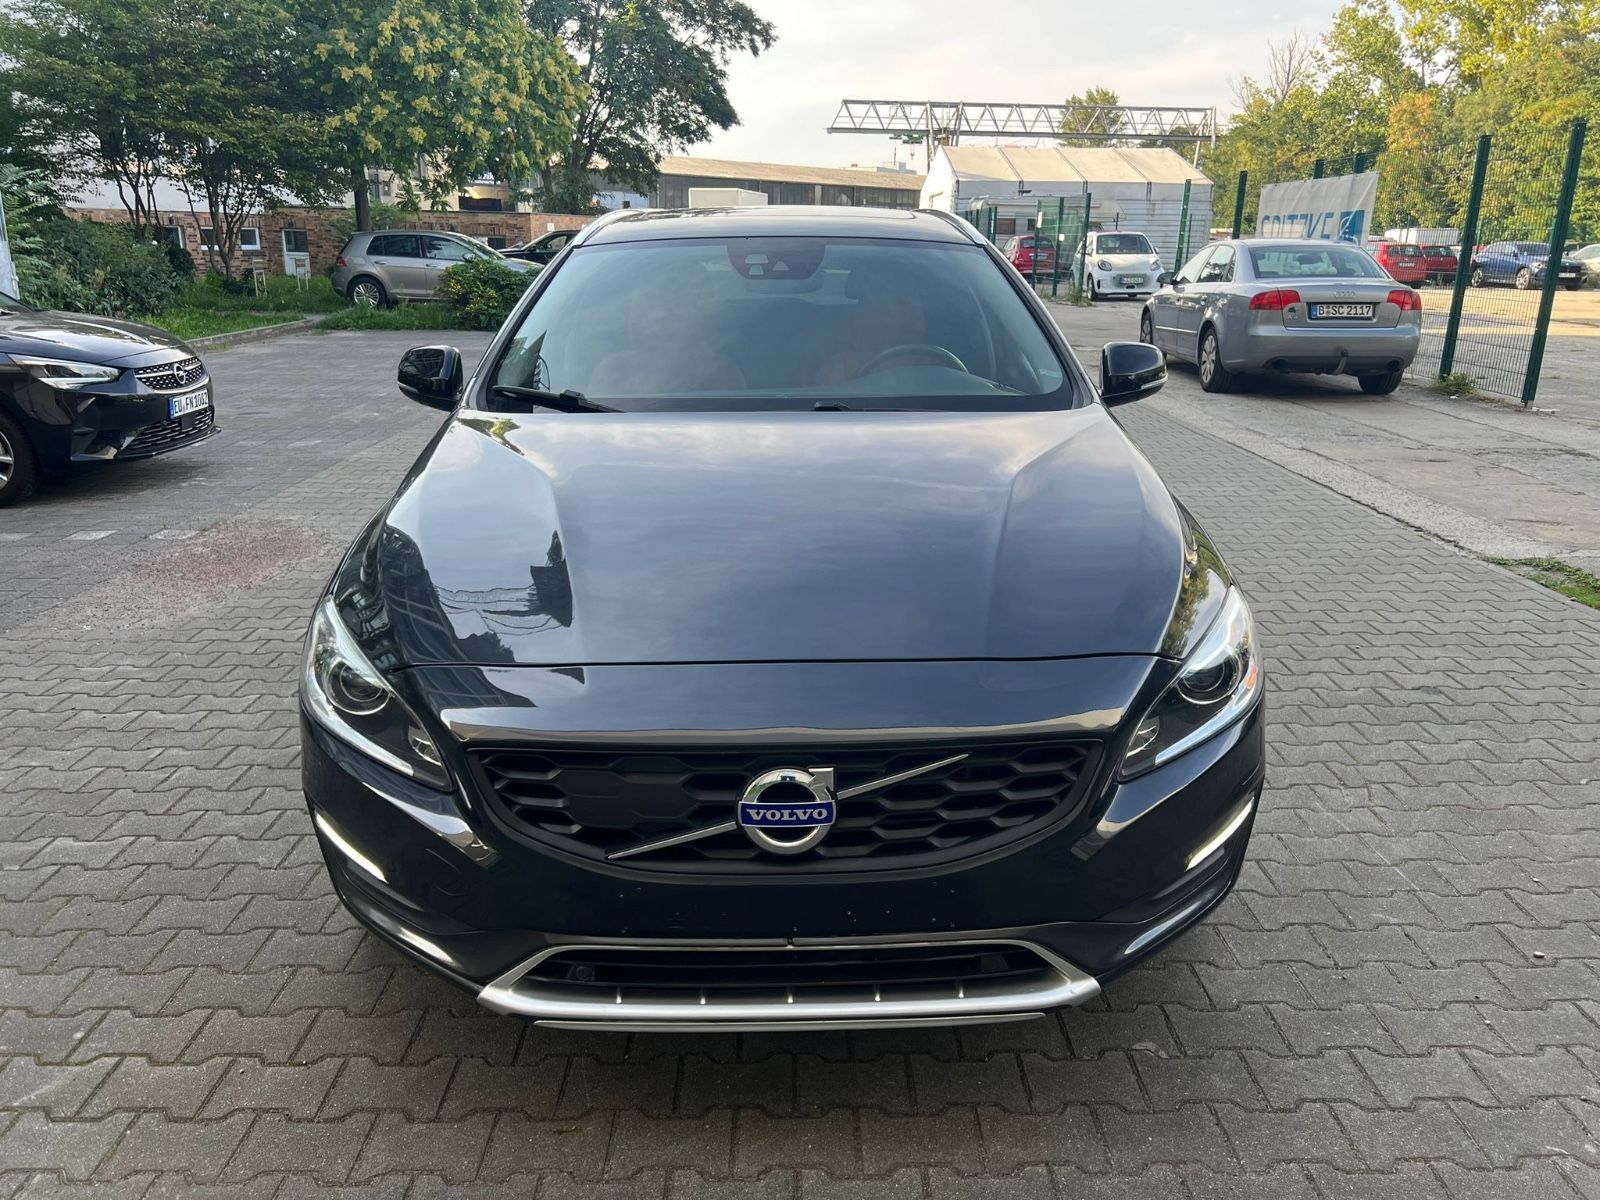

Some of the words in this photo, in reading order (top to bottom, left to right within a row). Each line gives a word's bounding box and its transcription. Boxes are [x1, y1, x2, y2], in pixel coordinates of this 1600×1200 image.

[1318, 305, 1325, 316] B
[1331, 305, 1344, 316] SC
[1346, 305, 1371, 316] 2117
[174, 400, 182, 413] EU
[746, 808, 828, 821] VOLVO
